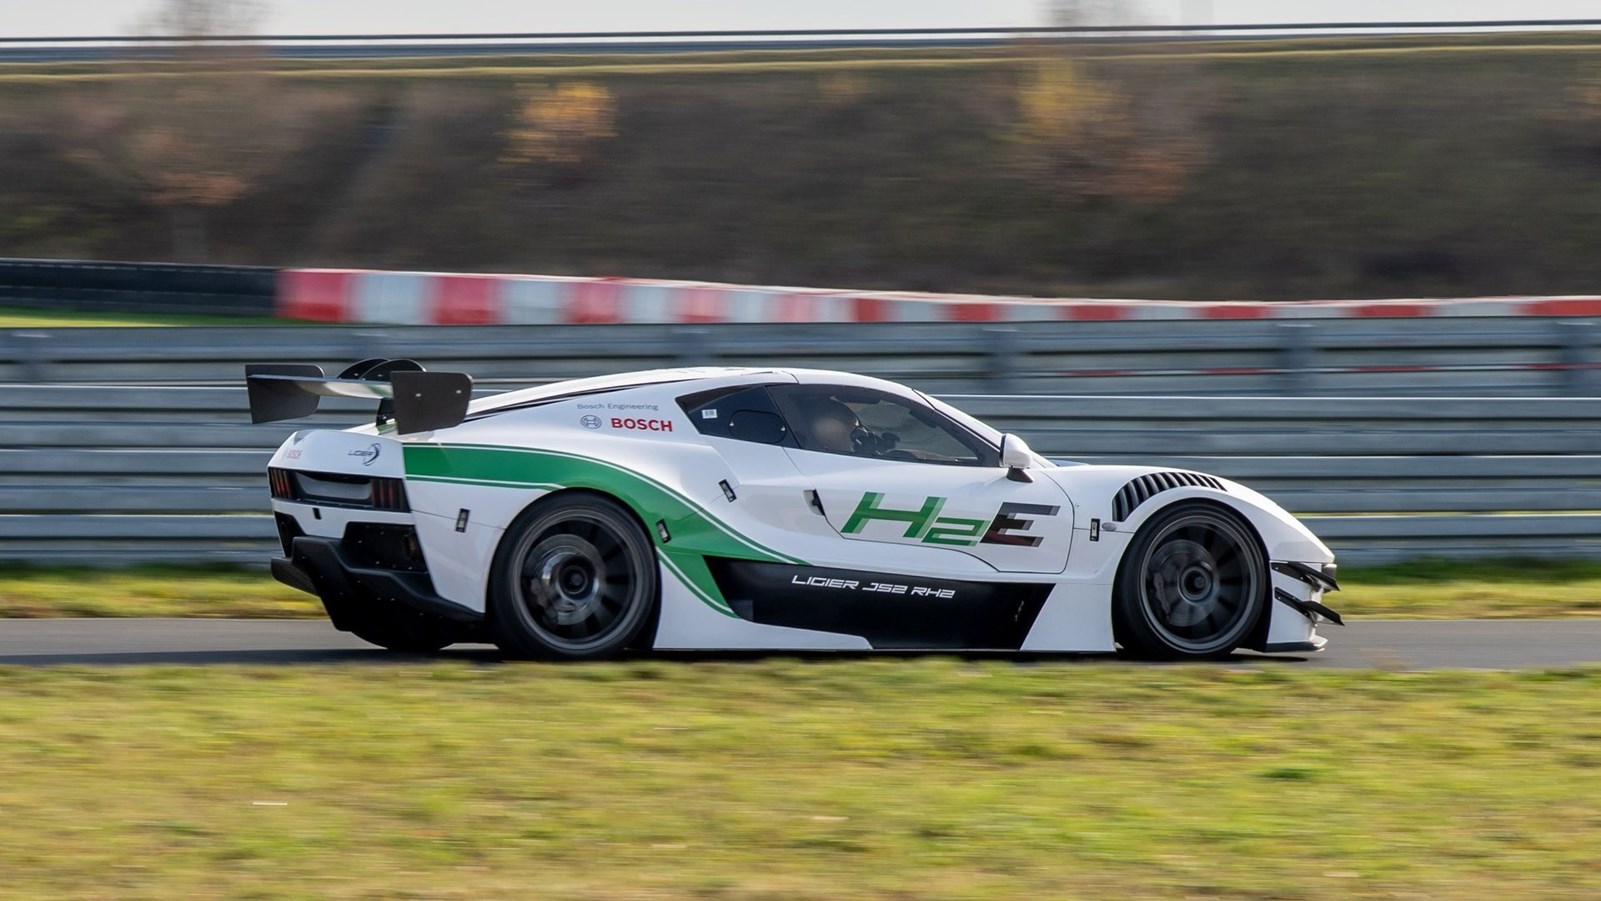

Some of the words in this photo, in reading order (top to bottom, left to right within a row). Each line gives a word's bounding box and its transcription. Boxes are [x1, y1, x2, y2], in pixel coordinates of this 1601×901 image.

[607, 403, 659, 411] Engineering
[611, 417, 673, 432] BOSCH
[840, 491, 1061, 548] H2E
[791, 575, 860, 590] LIGIER
[862, 582, 908, 594] JS2
[911, 586, 956, 599] RH2
